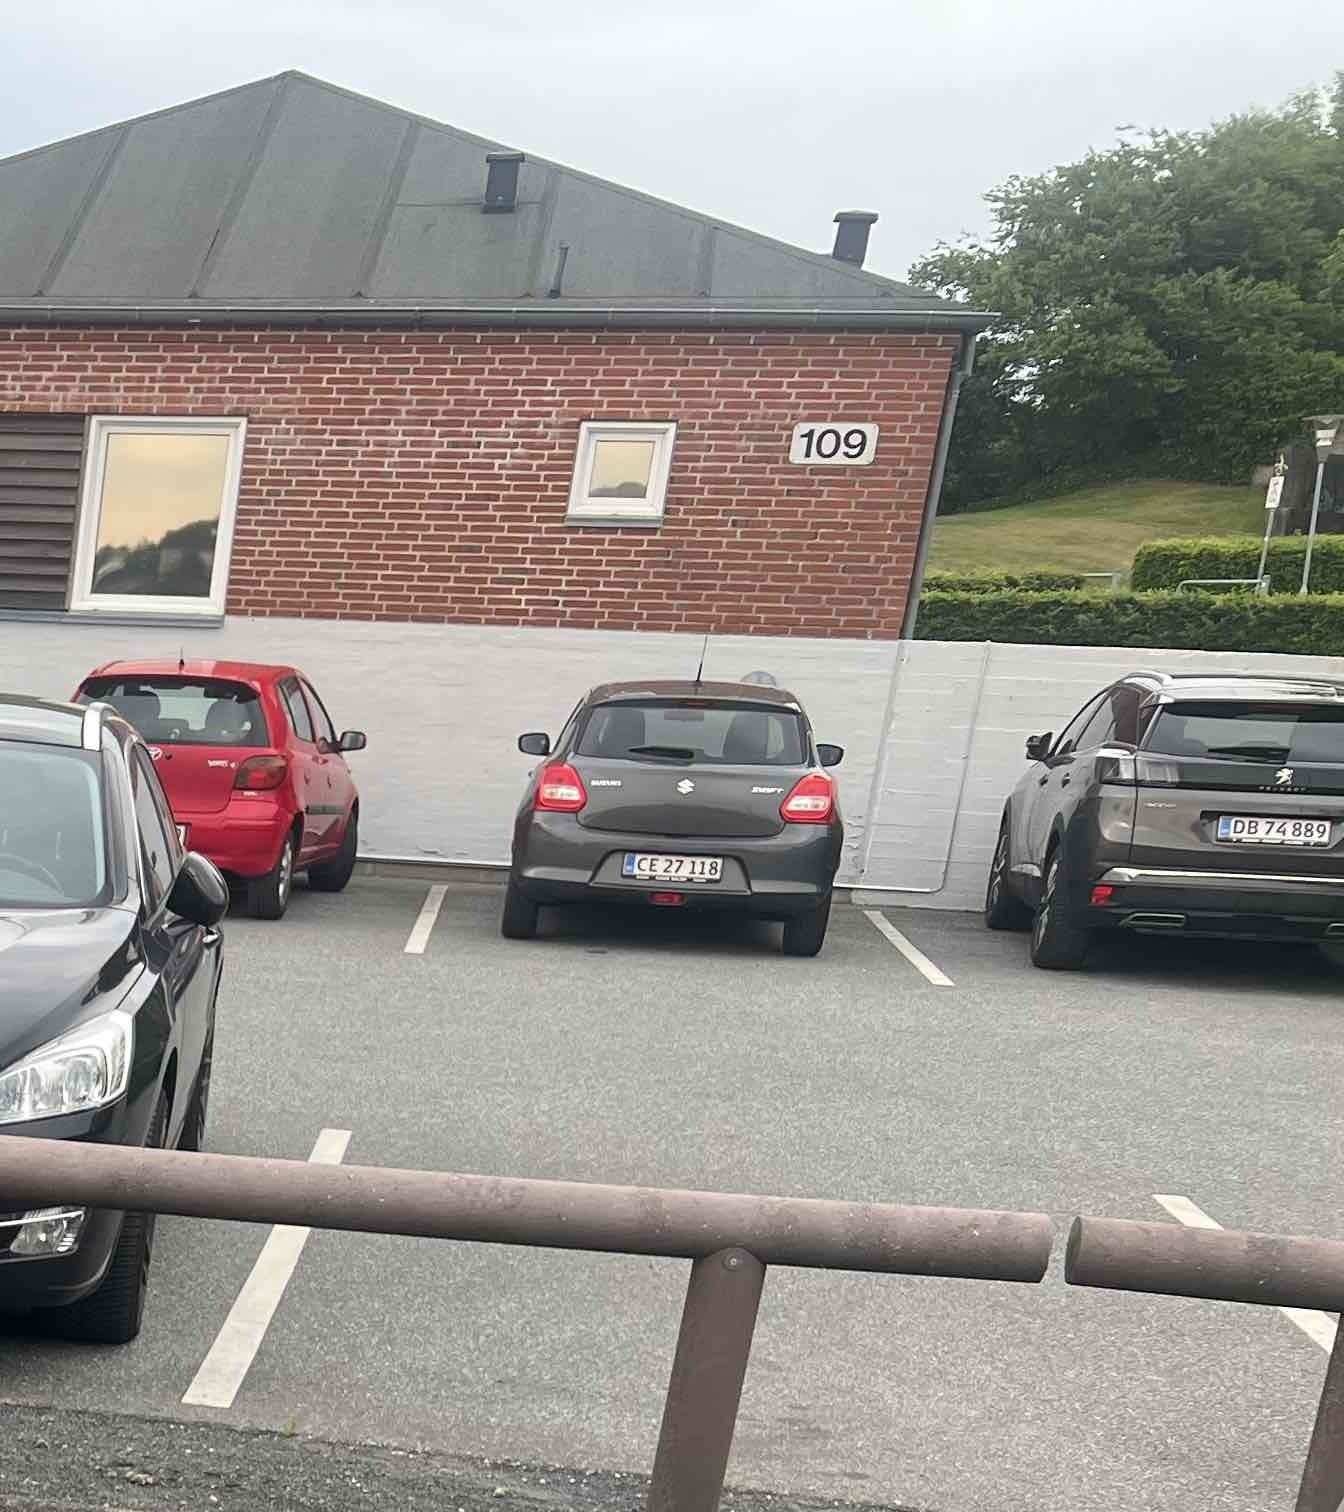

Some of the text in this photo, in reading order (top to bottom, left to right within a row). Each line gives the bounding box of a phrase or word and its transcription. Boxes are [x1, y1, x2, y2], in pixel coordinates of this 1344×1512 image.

[800, 429, 867, 458] 109
[1233, 820, 1326, 838] DB 74 889
[637, 857, 718, 875] CE 27 118
